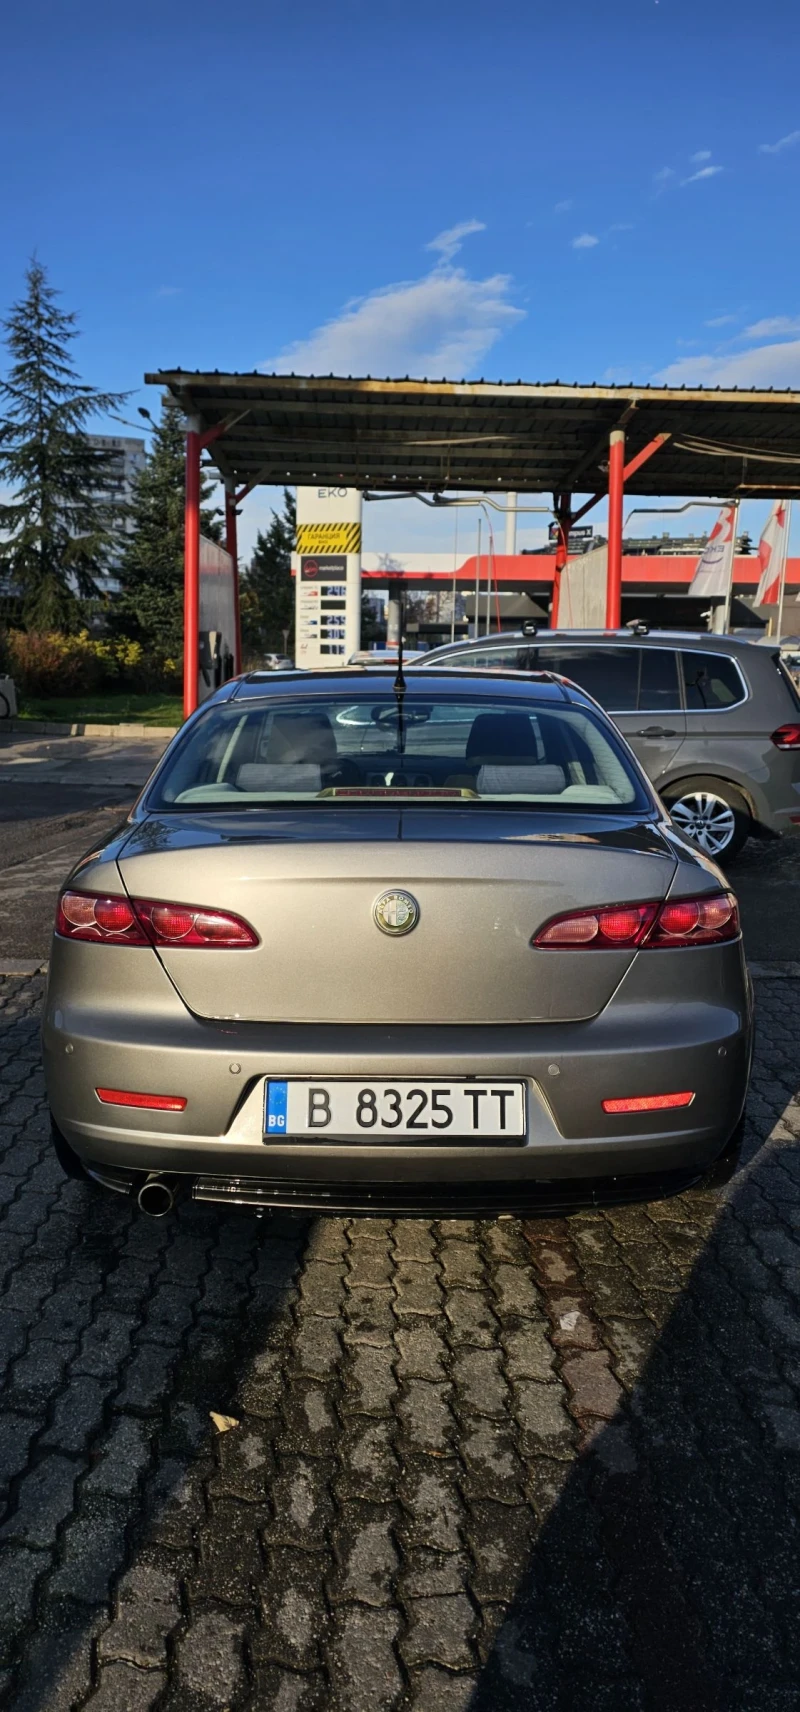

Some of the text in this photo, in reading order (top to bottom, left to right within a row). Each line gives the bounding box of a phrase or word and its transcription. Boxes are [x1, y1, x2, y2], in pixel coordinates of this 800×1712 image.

[318, 488, 347, 498] EKO
[307, 532, 340, 540] ГАРАНЦИЯ
[307, 1088, 515, 1129] B 8325 TT
[268, 1114, 285, 1127] BG
